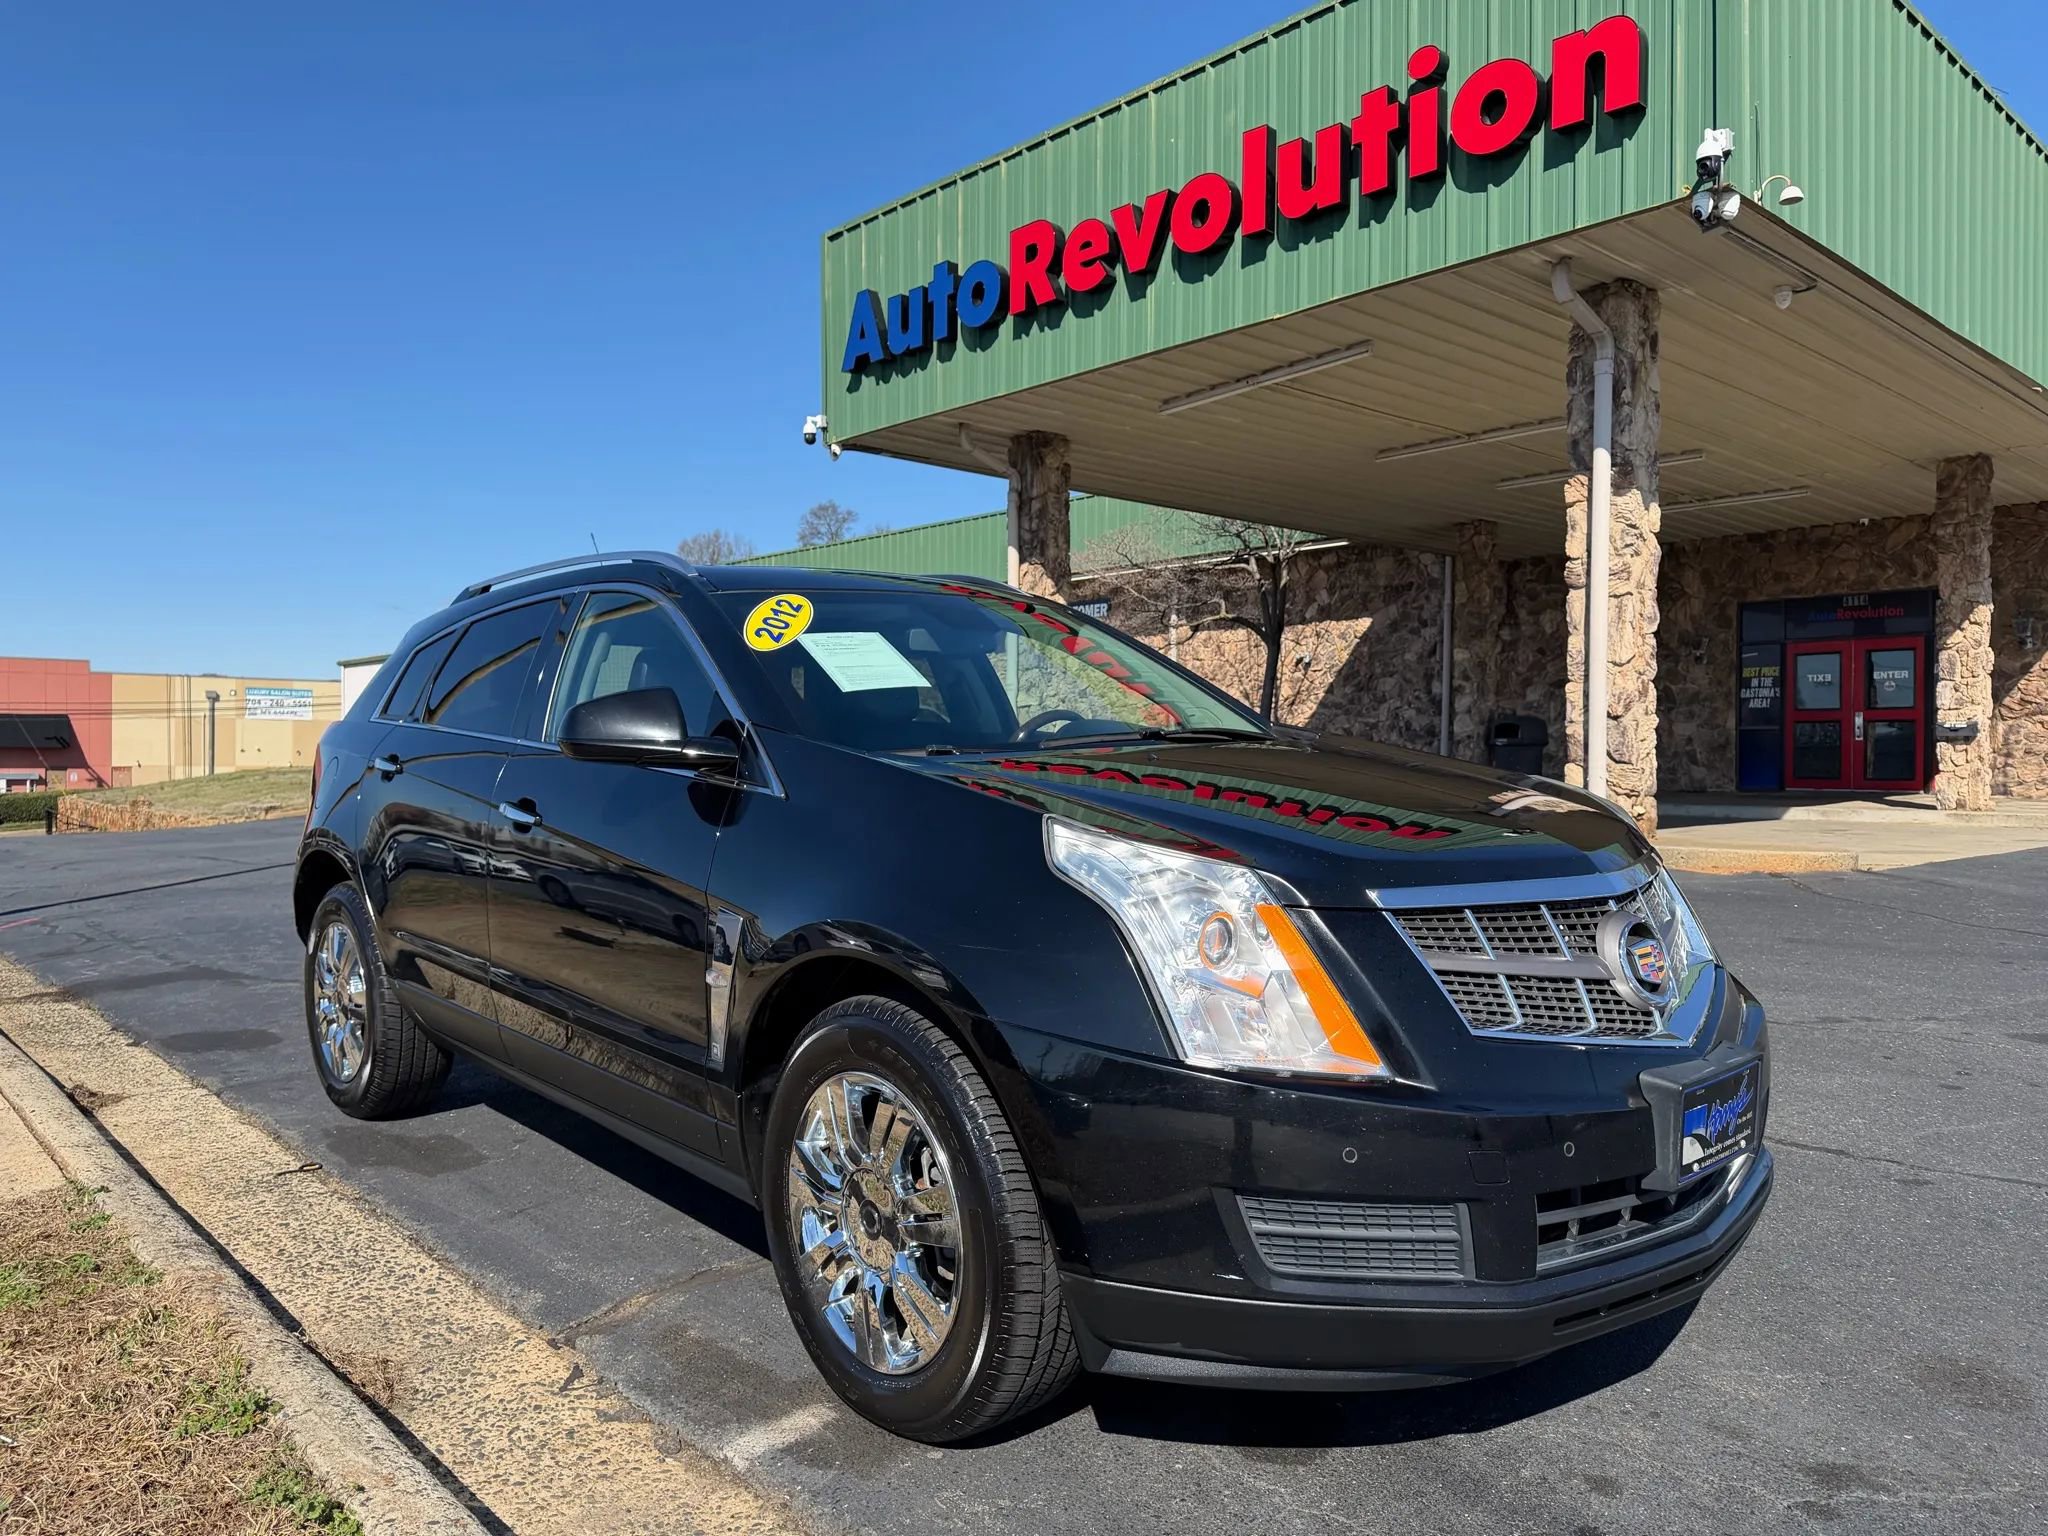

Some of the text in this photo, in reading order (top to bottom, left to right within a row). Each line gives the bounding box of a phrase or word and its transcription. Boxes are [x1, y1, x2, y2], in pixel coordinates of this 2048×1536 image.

[841, 14, 1647, 373] AutoRevolution
[754, 599, 803, 644] 2012
[1742, 667, 1760, 678] BEST
[1873, 670, 1909, 680] ENTER
[1751, 677, 1774, 687] IN THE
[1748, 698, 1770, 708] AREA!
